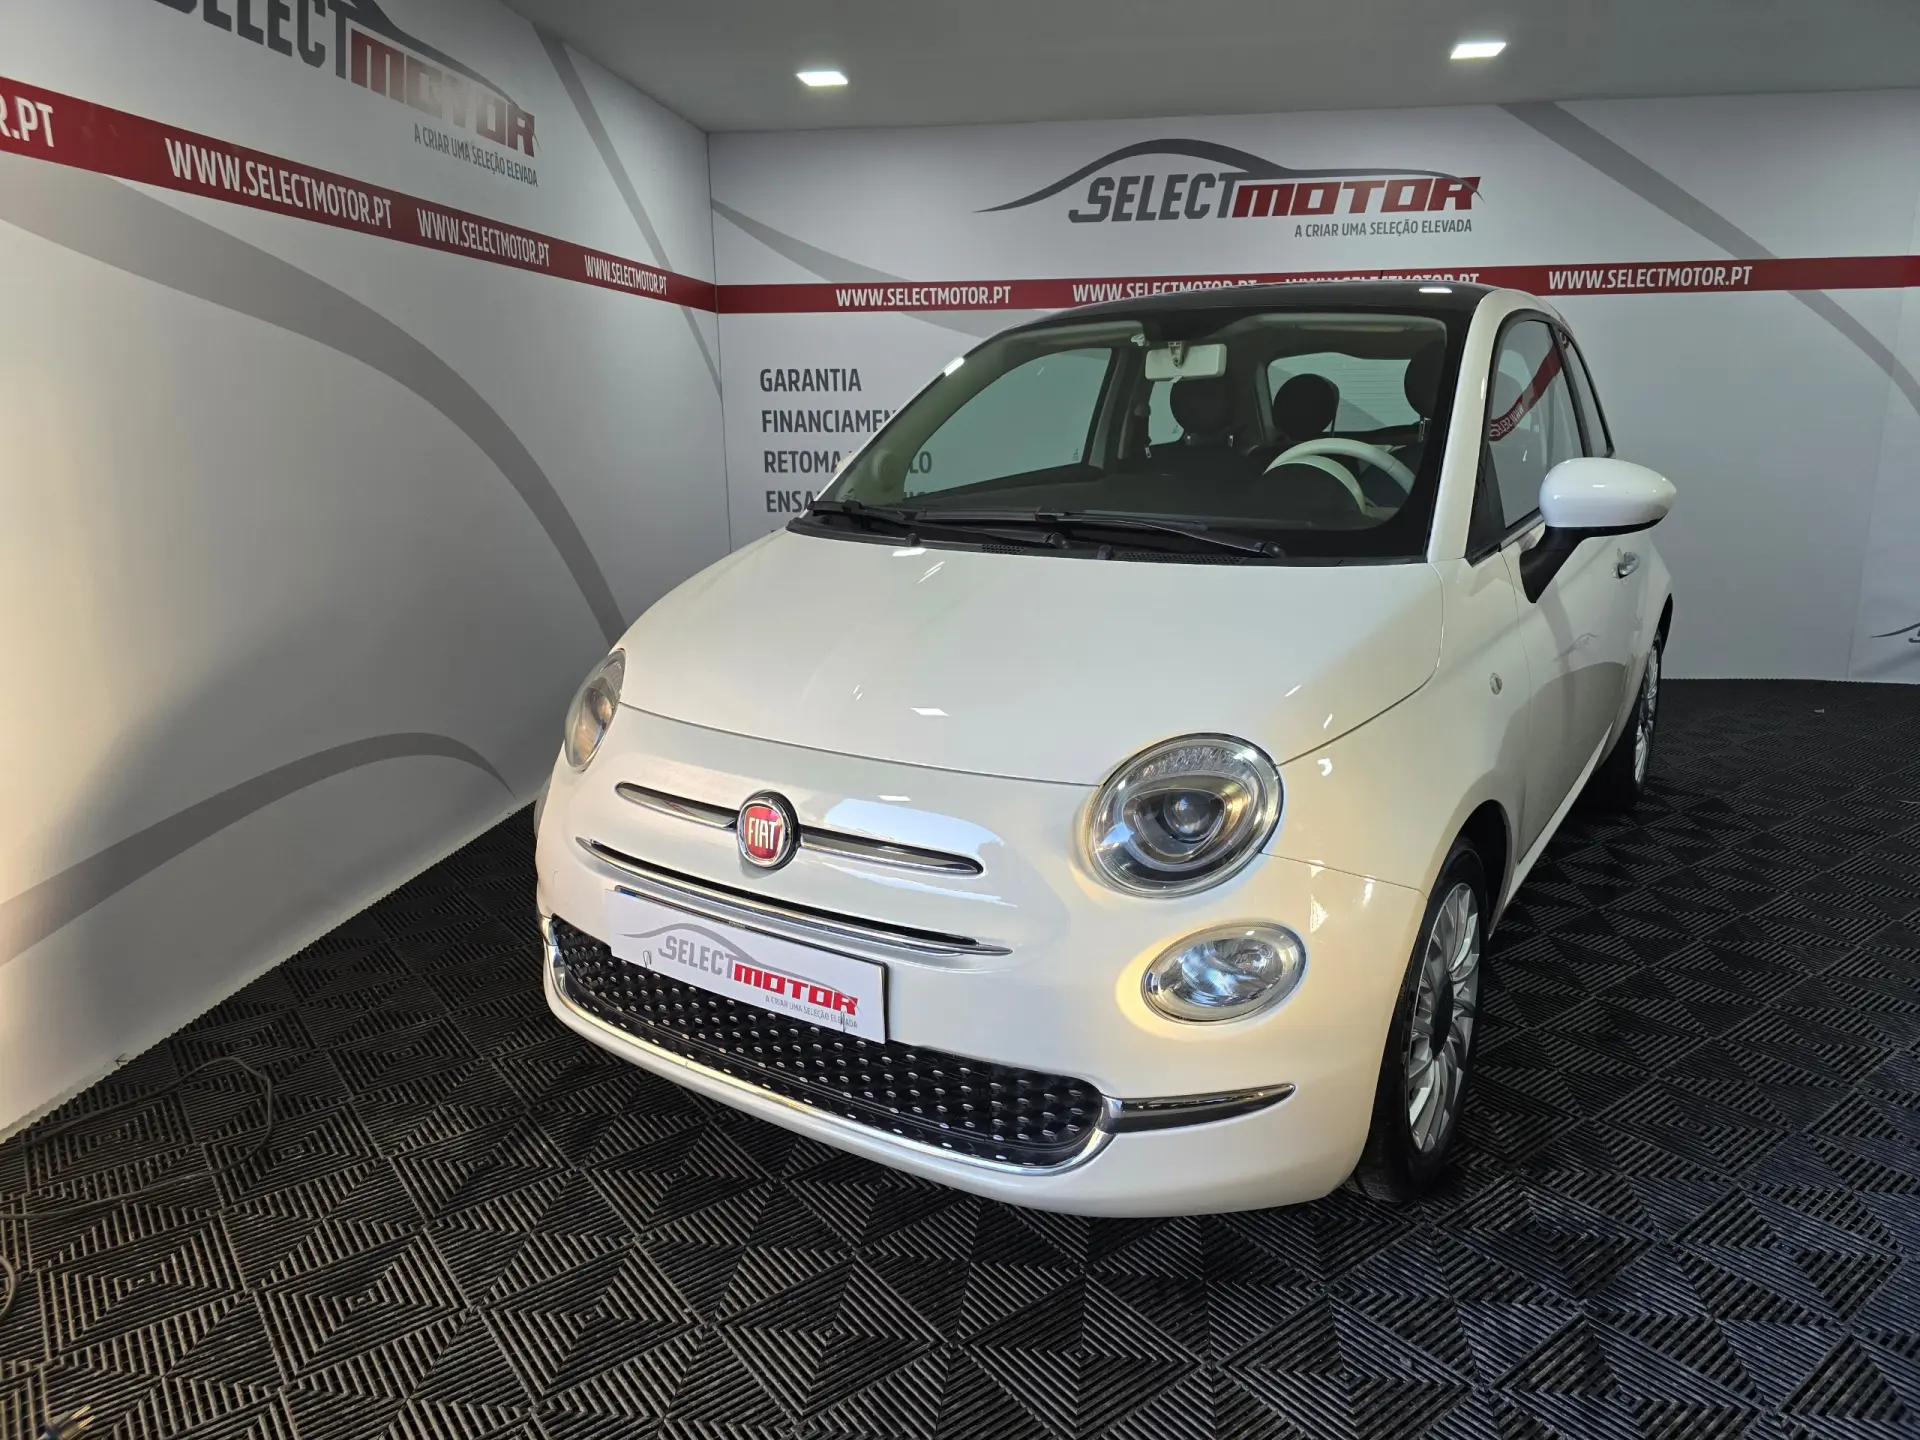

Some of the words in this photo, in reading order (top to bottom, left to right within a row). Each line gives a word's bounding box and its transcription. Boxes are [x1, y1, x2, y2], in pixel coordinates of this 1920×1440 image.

[414, 123, 421, 144] A
[422, 127, 450, 155] CRIAR
[450, 137, 471, 163] UMA
[471, 145, 505, 175] SELEÇÃO
[507, 159, 538, 187] ELEVADA
[165, 137, 392, 229] WWW.SELECTMOTOR.PT
[417, 208, 550, 267] WWW.SELECTMOTOR.PT
[585, 255, 667, 296] WWW.SELECTMOTOR.PT
[1295, 225, 1302, 237] A
[1306, 223, 1338, 237] CRIAR
[1342, 222, 1367, 236] UMA
[1370, 219, 1418, 237] SELEÇÃO
[1421, 219, 1472, 233] ELEVADA
[836, 286, 1011, 307] WWW.SELECTMOTOR.PT
[1549, 266, 1753, 289] WWW.SELECTMOTOR.PT
[760, 368, 862, 392] GARANTIA
[764, 450, 841, 473] RETOMA
[748, 817, 777, 850] FIAT
[770, 996, 788, 1008] CRIAR
[789, 1002, 802, 1012] UMA
[831, 1014, 858, 1028] ELEADA
